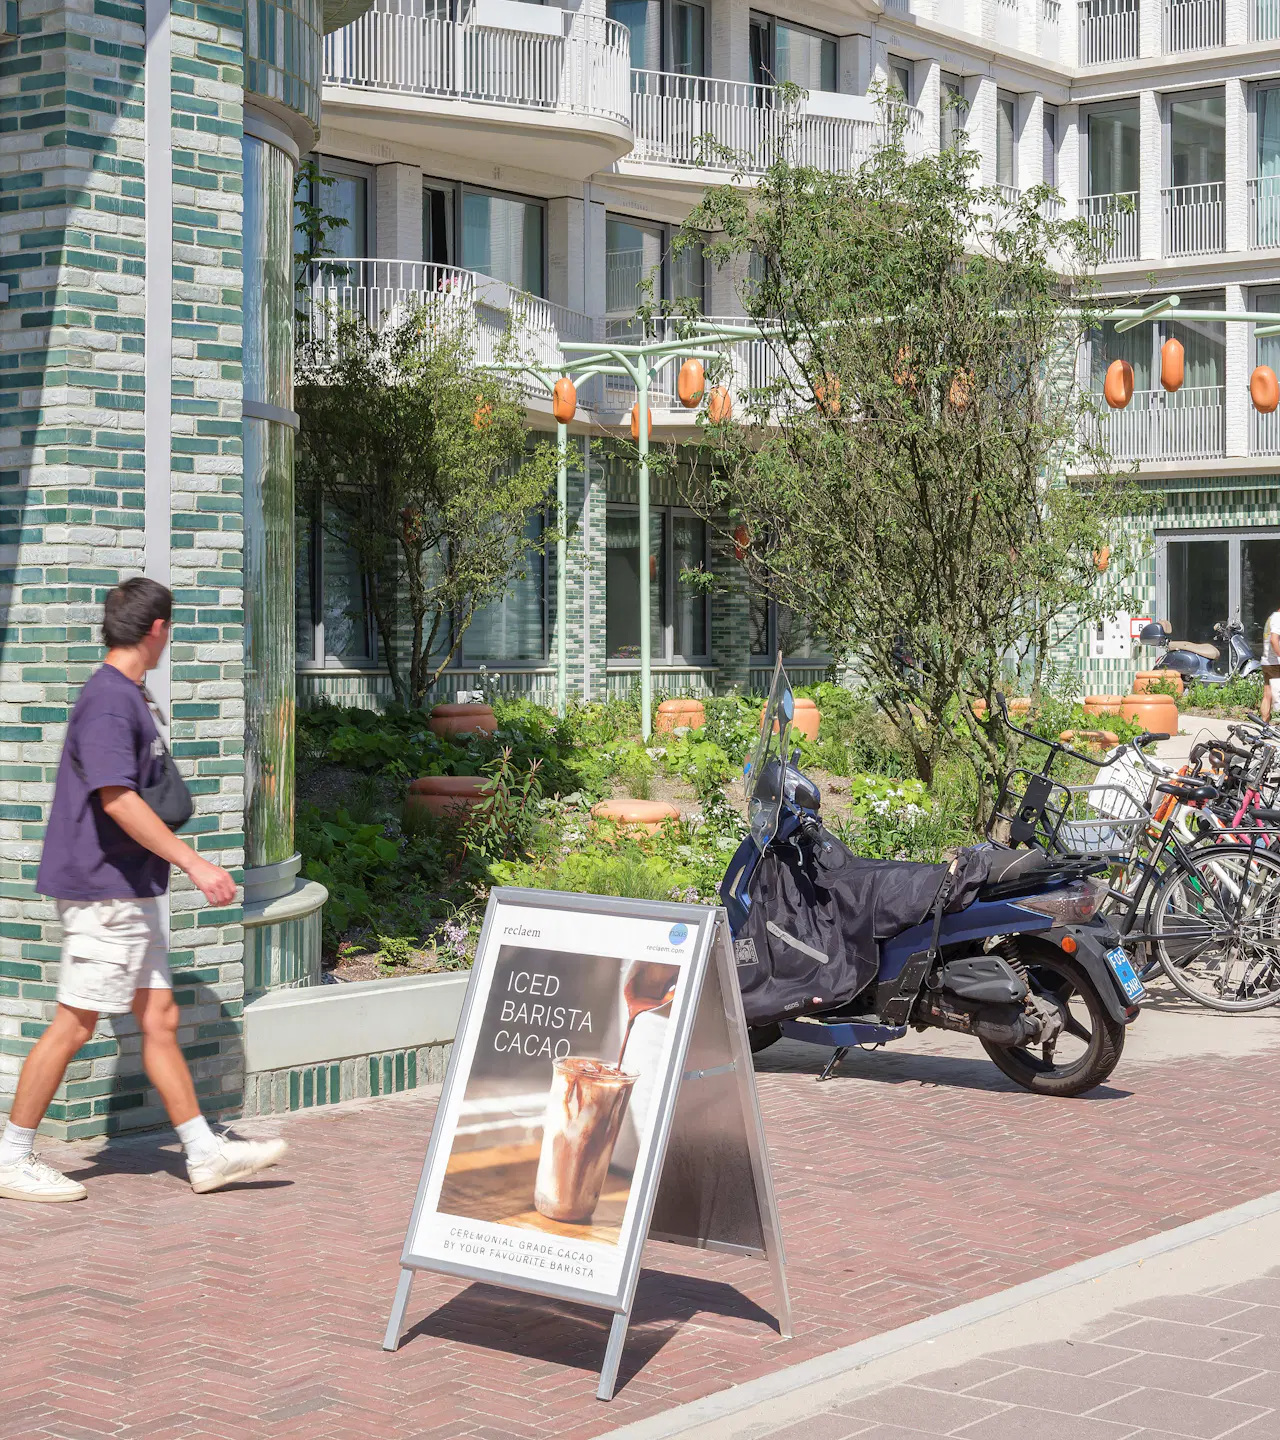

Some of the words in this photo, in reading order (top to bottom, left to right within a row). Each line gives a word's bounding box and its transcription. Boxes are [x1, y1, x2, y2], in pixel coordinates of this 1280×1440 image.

[503, 924, 541, 938] reclaem
[669, 930, 687, 938] nous
[646, 945, 684, 953] reclaem.com
[1109, 951, 1125, 968] F05
[507, 970, 560, 997] ICED
[500, 1000, 593, 1033] BARISTA
[494, 1030, 571, 1059] CACAO
[443, 1240, 456, 1250] BY
[460, 1243, 486, 1256] YOUR
[489, 1248, 546, 1268] FAVOURITE
[550, 1261, 595, 1278] BARISTA
[450, 1227, 515, 1248] CEREMONIAL
[518, 1240, 554, 1256] GRADE
[557, 1249, 594, 1264] CACAO
